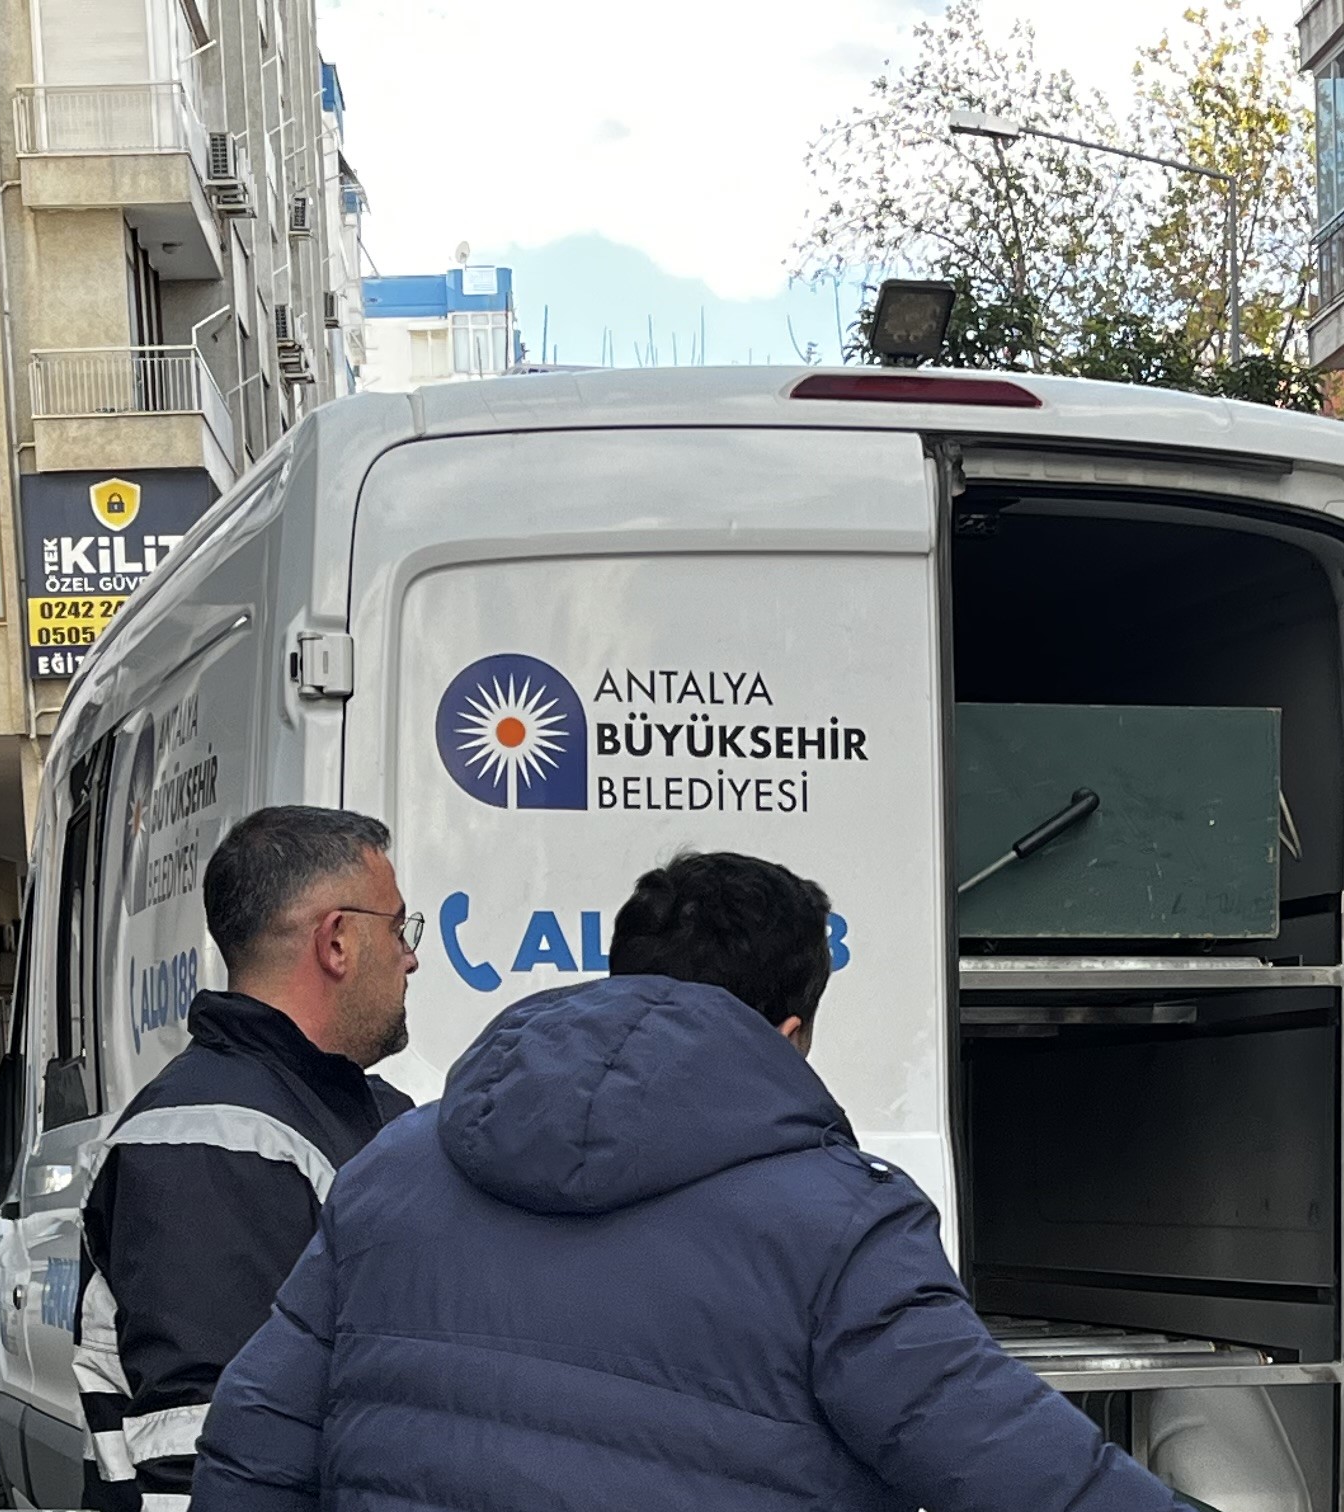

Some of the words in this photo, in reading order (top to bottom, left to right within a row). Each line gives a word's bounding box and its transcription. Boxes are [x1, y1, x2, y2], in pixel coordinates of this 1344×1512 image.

[43, 537, 59, 575] TEK
[45, 574, 95, 593] ÖZEL
[40, 600, 95, 620] 0242
[37, 626, 96, 646] 0505
[593, 668, 774, 706] ANTALYA
[597, 768, 809, 813] BELEDİYESİ
[510, 910, 612, 973] AL
[140, 959, 169, 1034] ALO
[172, 946, 198, 1022] 188
